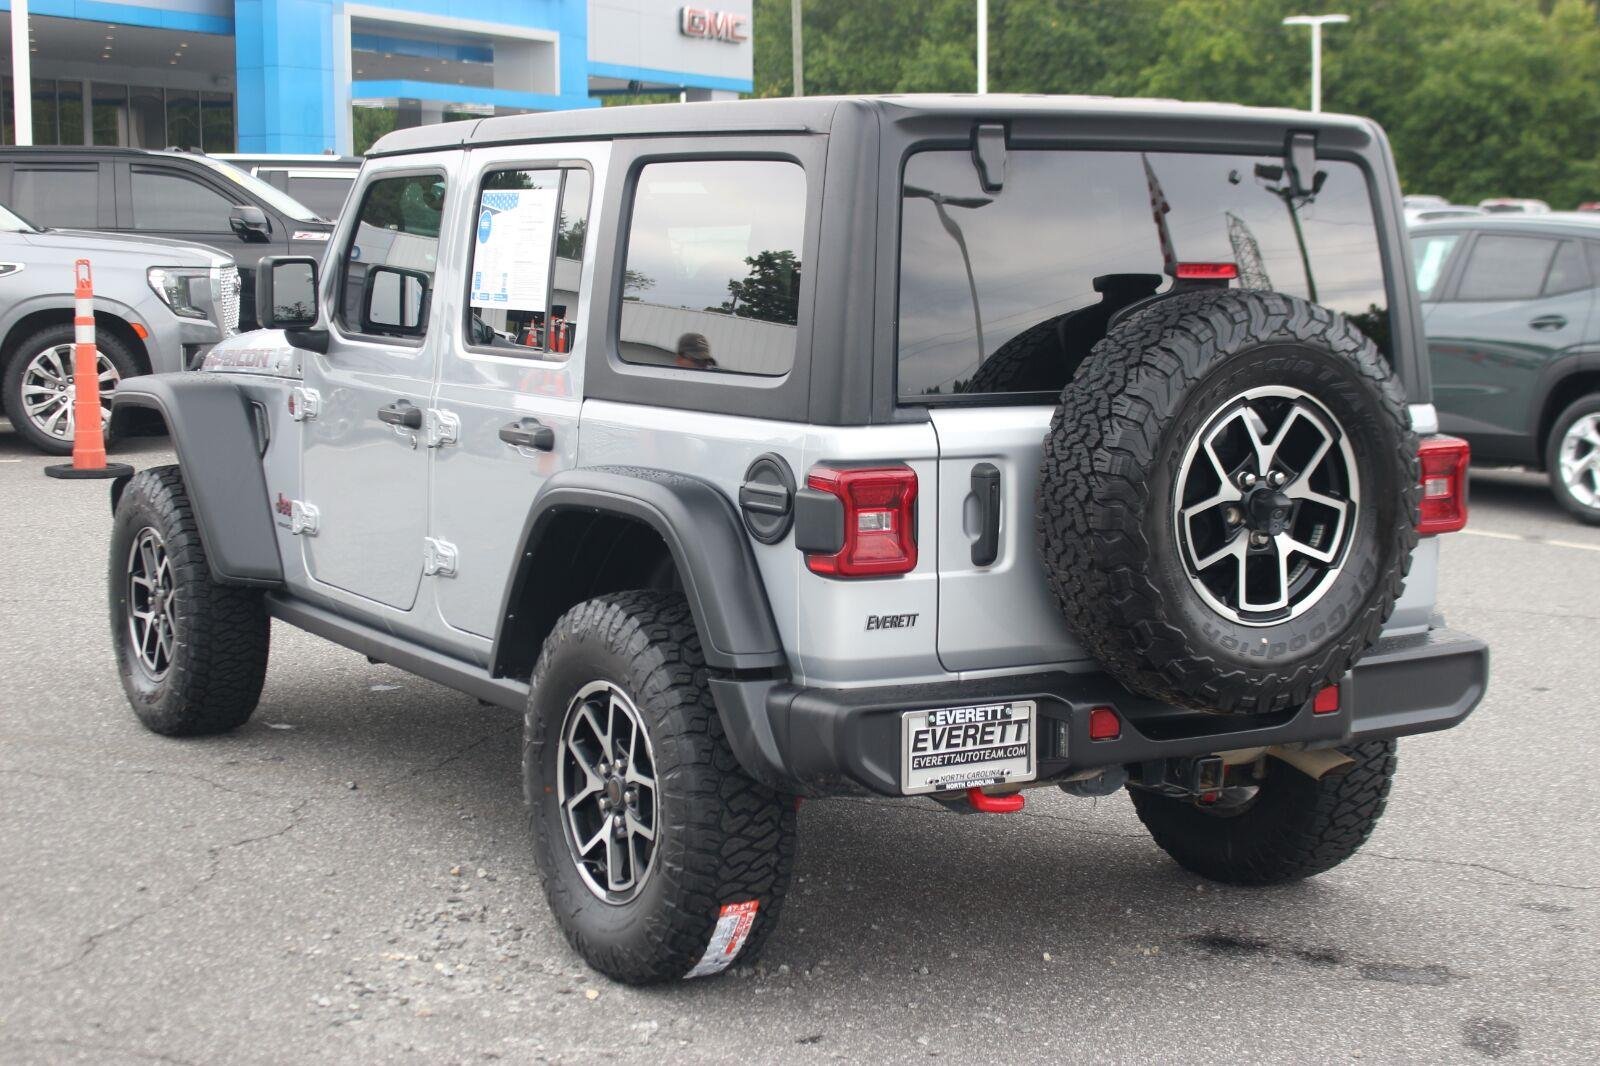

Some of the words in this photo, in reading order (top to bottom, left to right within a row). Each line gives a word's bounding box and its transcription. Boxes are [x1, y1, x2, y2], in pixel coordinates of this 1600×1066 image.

[680, 6, 747, 43] GMC
[866, 612, 919, 630] EVERETT
[935, 705, 1005, 726] EVERETT
[912, 719, 1028, 752] EVERETT
[914, 747, 1026, 767] EVERETTAUTOTEAM.COM
[940, 772, 965, 782] NORTH
[966, 769, 1000, 781] CAROLINA
[967, 778, 995, 787] CAROLINA
